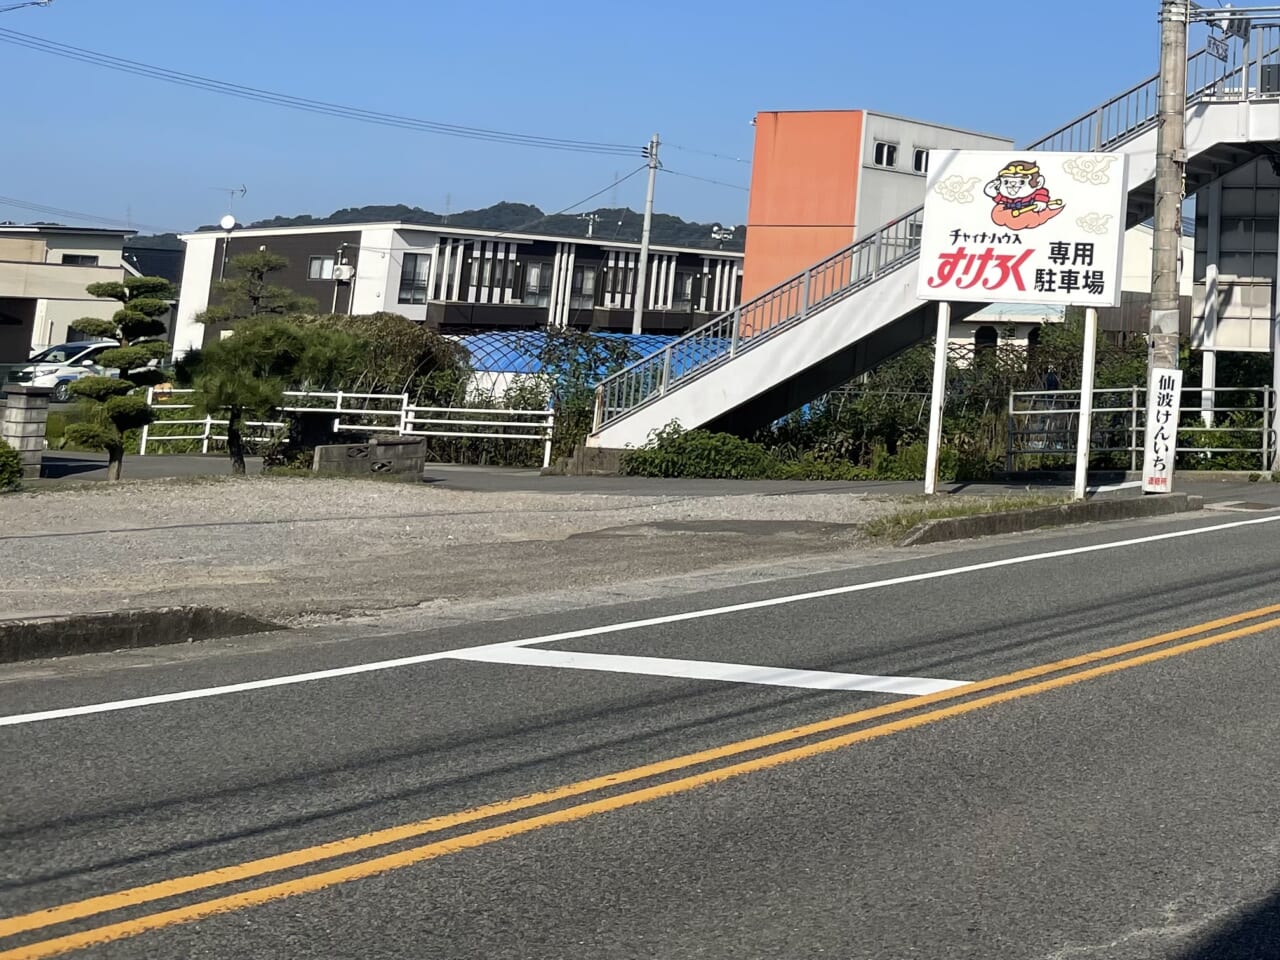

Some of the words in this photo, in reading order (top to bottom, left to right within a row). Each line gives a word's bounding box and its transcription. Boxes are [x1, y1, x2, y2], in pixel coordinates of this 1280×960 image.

[927, 246, 1037, 292] すけろく
[1048, 241, 1095, 267] 専用
[1033, 268, 1105, 295] 駐車場
[1153, 375, 1175, 472] 仙波けんいち
